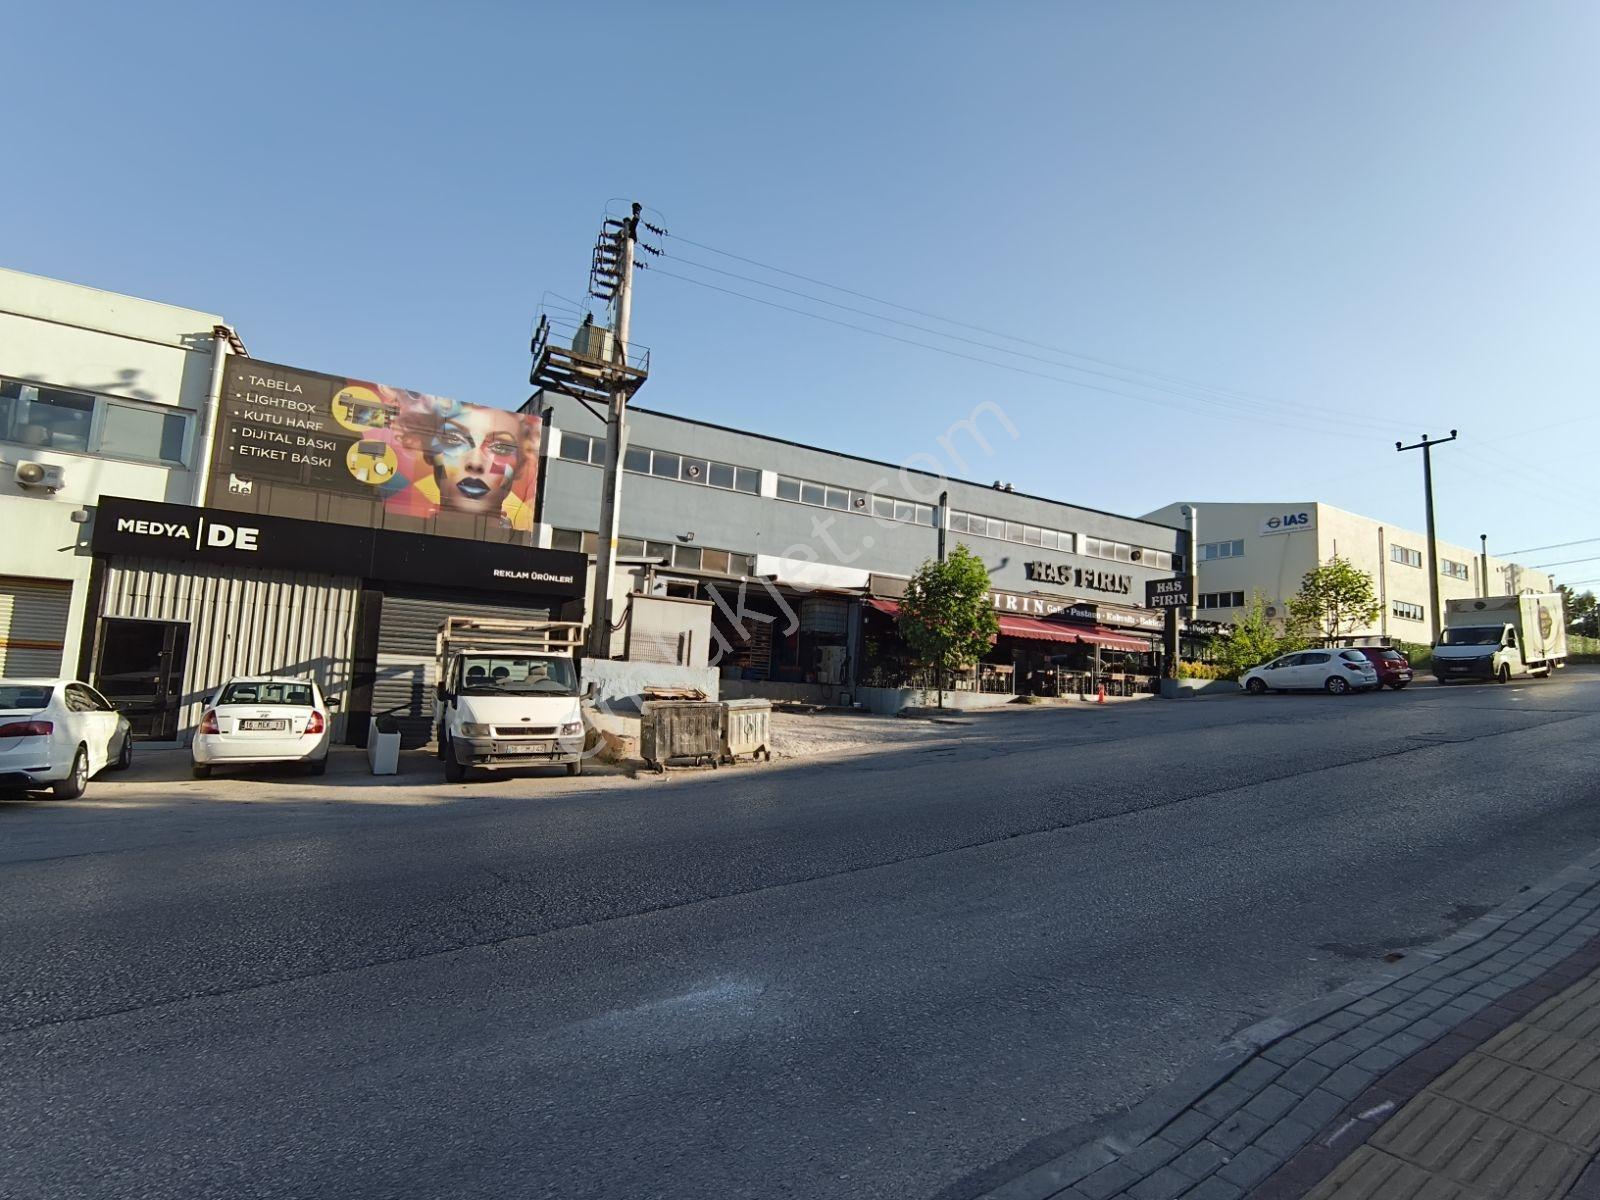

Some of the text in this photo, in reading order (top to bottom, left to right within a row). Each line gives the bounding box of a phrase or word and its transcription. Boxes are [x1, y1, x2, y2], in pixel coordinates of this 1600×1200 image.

[249, 375, 302, 394] TABELA
[246, 393, 316, 413] LIGHTBOX
[244, 410, 324, 431] KUTU HARF
[241, 427, 337, 451] DİJİTAL BASKI
[239, 445, 332, 468] ETİKET BASKI
[117, 518, 190, 539] MEDYA
[1283, 512, 1309, 526] IAS
[207, 523, 259, 551] DE
[493, 569, 574, 584] REKLAM ÜRÜNLERİ
[1030, 560, 1132, 594] HAS FIRIN
[1156, 580, 1182, 593] HAS
[1151, 593, 1188, 607] FIRIN
